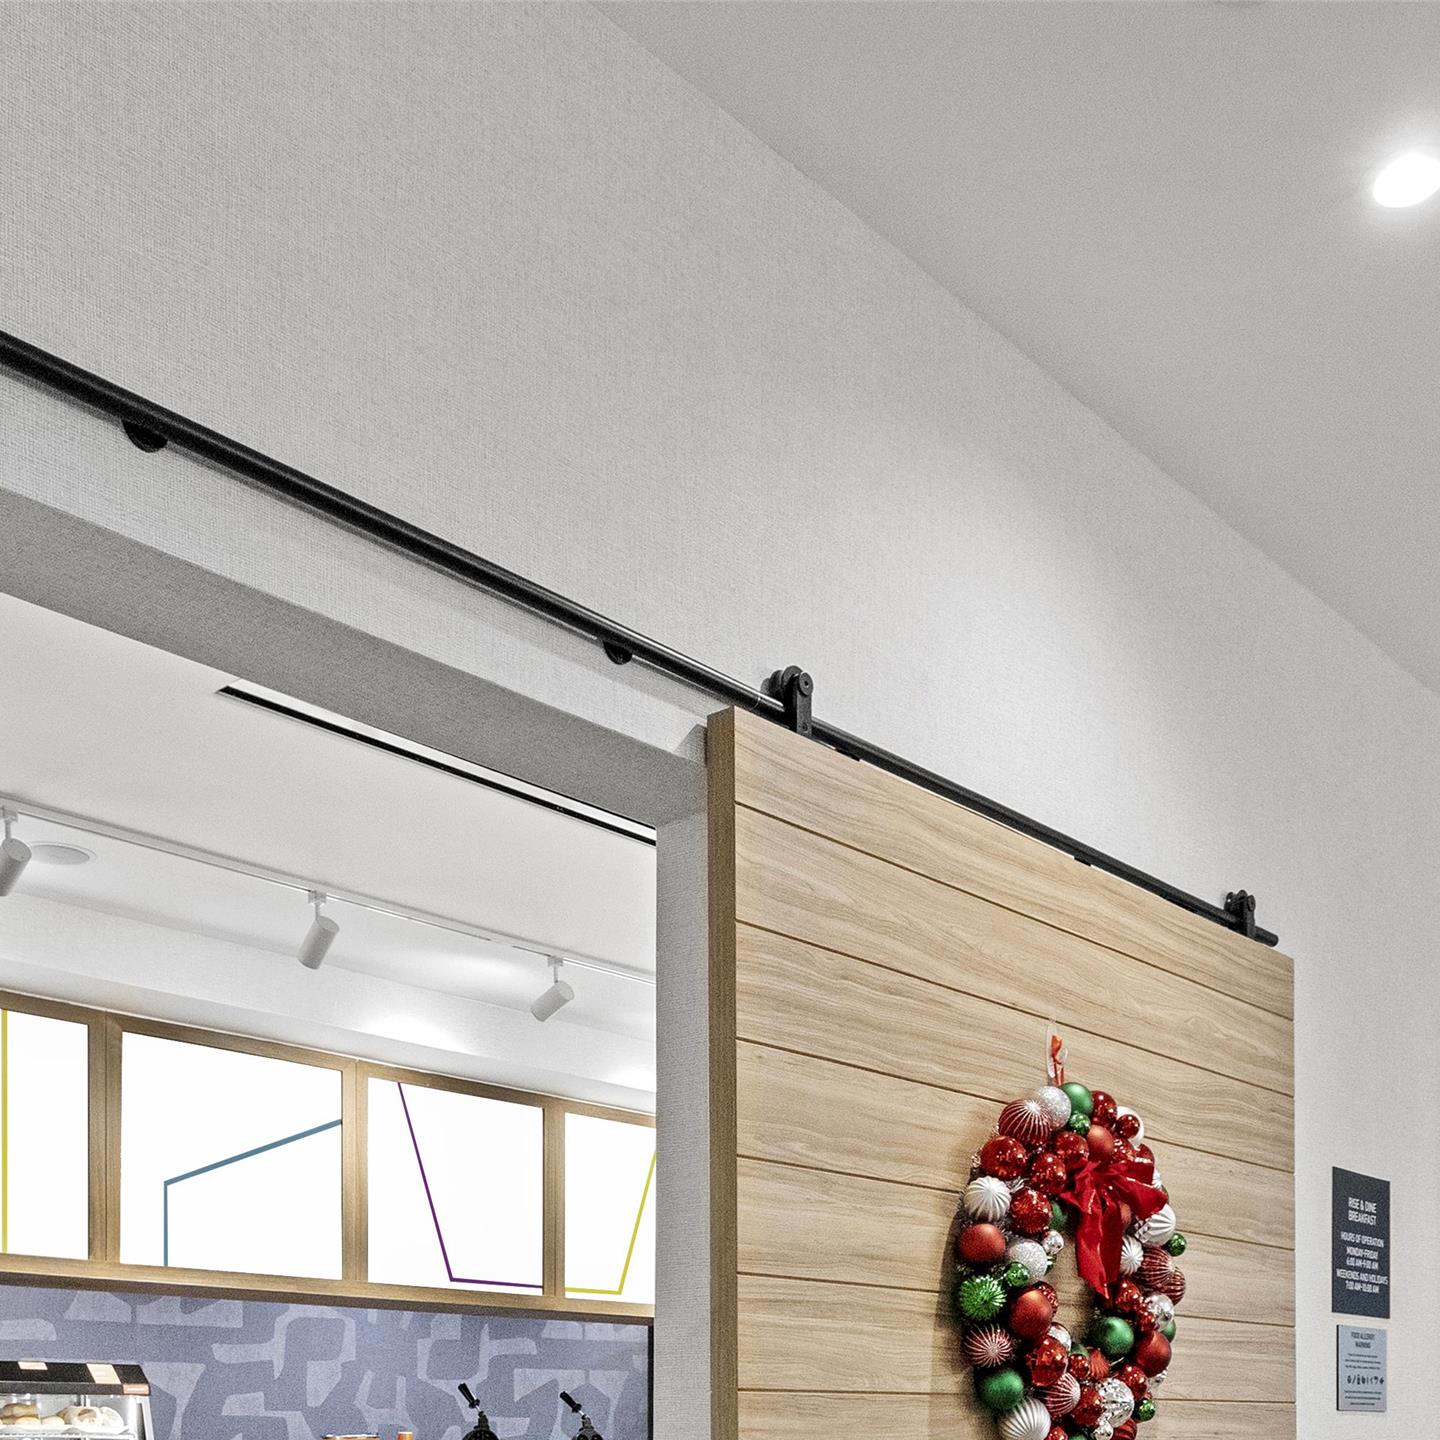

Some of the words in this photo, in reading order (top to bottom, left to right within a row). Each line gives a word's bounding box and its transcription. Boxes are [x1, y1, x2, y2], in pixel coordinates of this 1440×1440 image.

[1348, 1197, 1360, 1210] RISE
[1364, 1200, 1377, 1214] DINE
[1348, 1210, 1377, 1226] BREAKFAST
[1340, 1231, 1356, 1243] HOURS
[1355, 1234, 1362, 1244] OF
[1361, 1235, 1385, 1248] OPERATION
[1336, 1268, 1360, 1280] WEEKENDS
[1360, 1272, 1369, 1282] AND
[1369, 1274, 1389, 1286] HOLIDAYS
